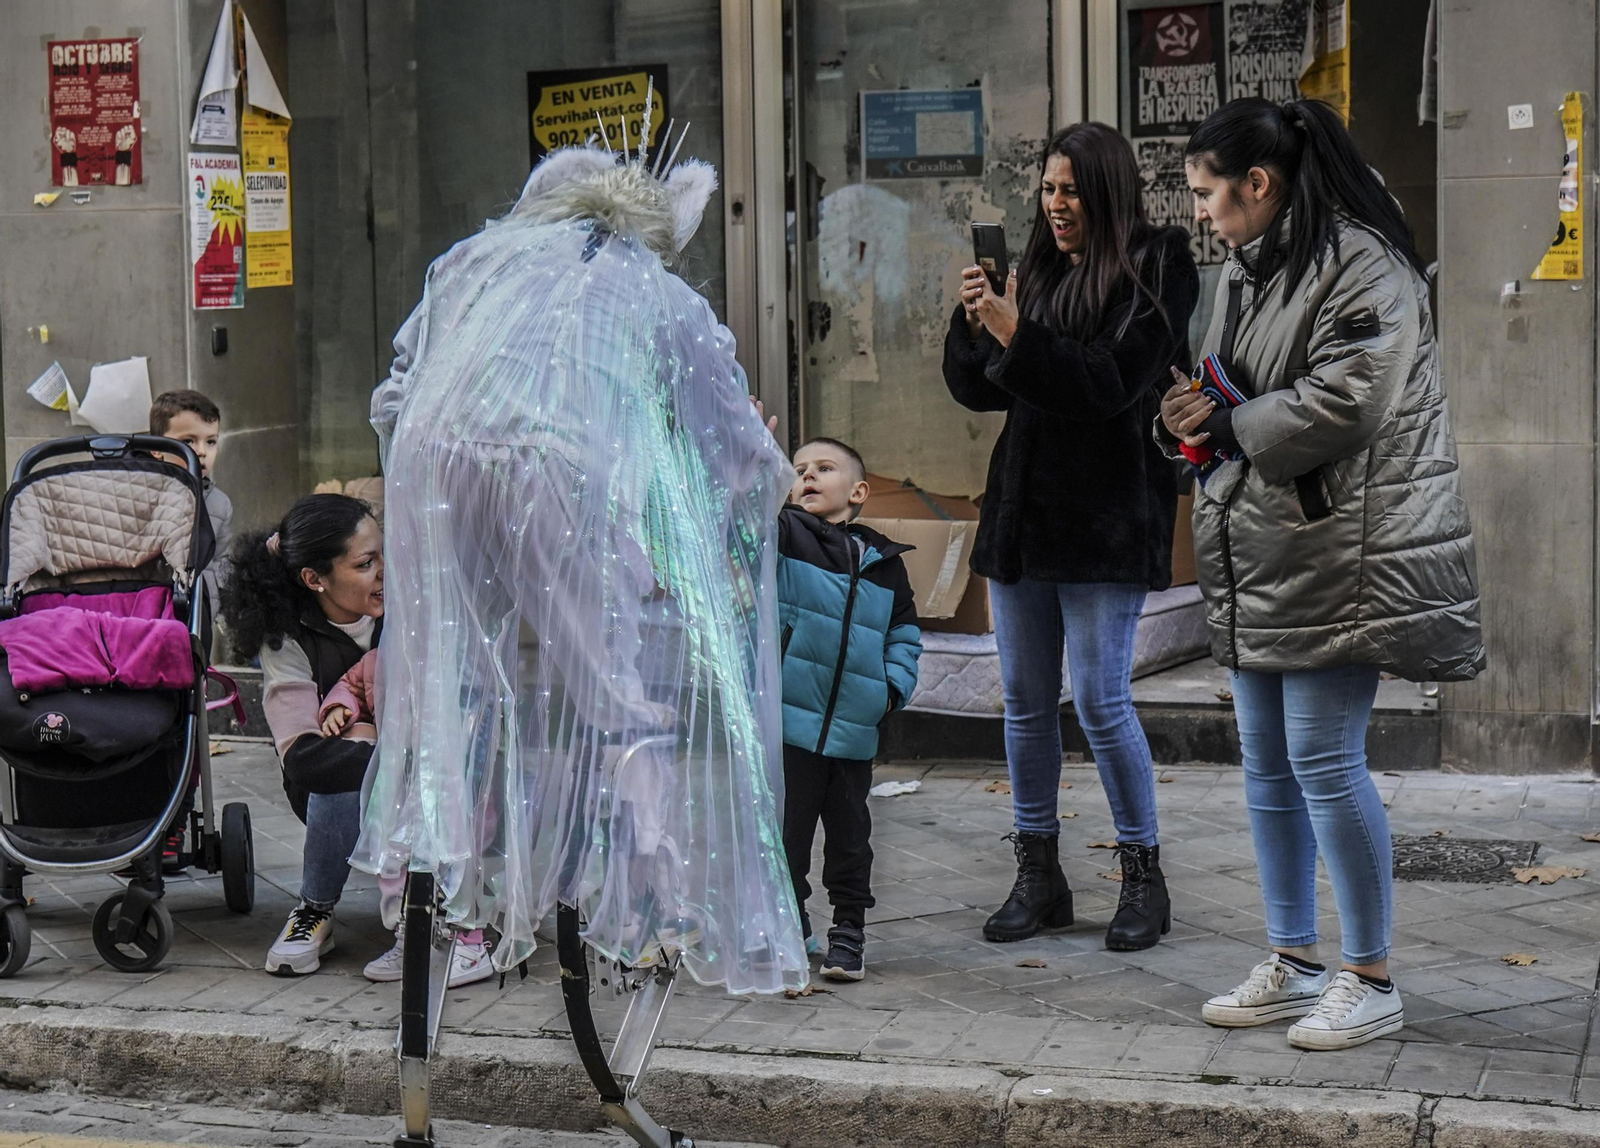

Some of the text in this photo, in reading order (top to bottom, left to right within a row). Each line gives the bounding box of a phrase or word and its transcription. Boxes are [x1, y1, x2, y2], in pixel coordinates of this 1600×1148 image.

[52, 42, 132, 66] OCTUBRE
[1231, 51, 1300, 83] PRISIONER
[552, 81, 636, 106] EN VENTA
[1139, 75, 1218, 100] LA RABIA
[1139, 99, 1154, 125] EN
[549, 129, 579, 149] 902
[205, 159, 238, 170] ACADEMIA
[907, 159, 966, 173] CaixaBank
[246, 175, 287, 190] SELECTIVIDAD
